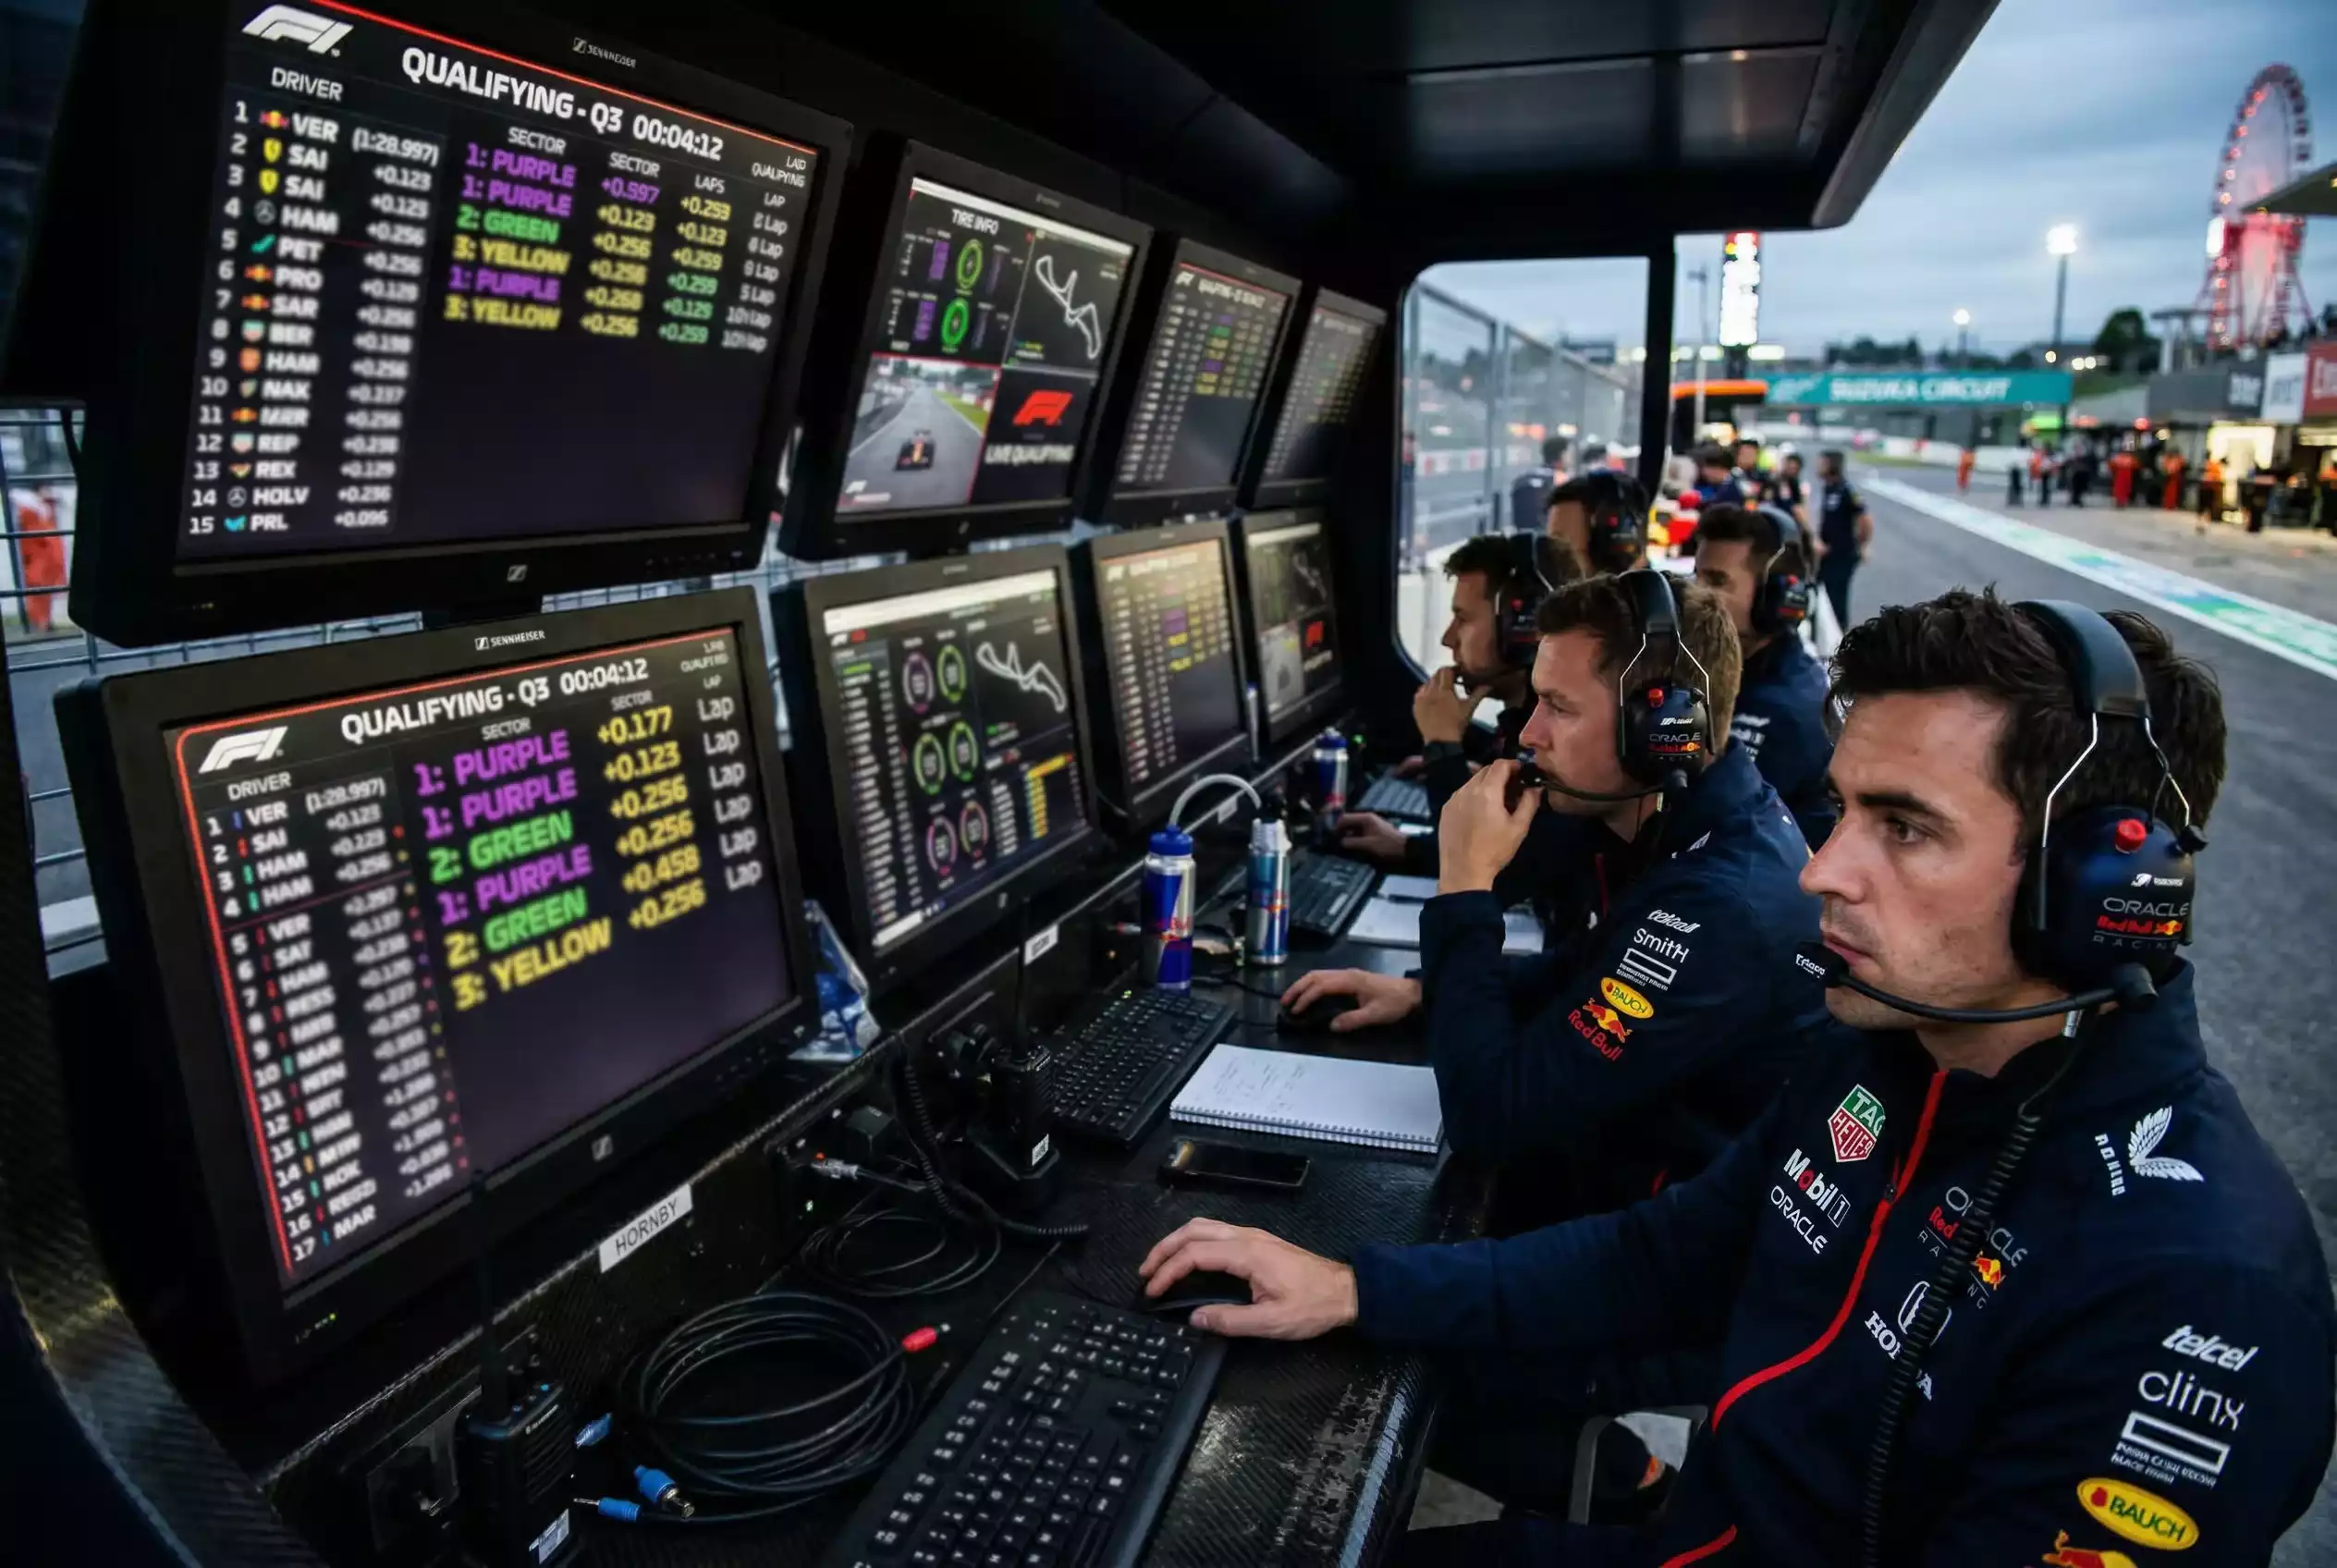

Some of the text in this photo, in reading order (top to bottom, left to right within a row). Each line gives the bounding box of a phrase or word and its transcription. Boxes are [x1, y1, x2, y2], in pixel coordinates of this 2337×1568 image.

[271, 67, 343, 101] DRIVER
[402, 47, 574, 119] QUALIFYING
[591, 103, 623, 134] Q3
[633, 115, 724, 161] 00:04:12
[235, 101, 248, 123] 1
[292, 113, 338, 142] VER
[231, 133, 247, 154] 2
[288, 144, 327, 170] SAI
[508, 127, 567, 155] SECTOR
[465, 142, 577, 188] 1: PURPLE
[609, 152, 660, 178] SECTOR
[228, 165, 324, 200] 3 SAI
[462, 174, 572, 217] 1: PURPLE
[695, 174, 725, 194] LAPS
[224, 197, 241, 218] 4
[281, 205, 338, 234] HAM
[457, 204, 559, 244] 2: GREEN
[222, 228, 238, 251] 5
[481, 239, 570, 274] YELLOW
[219, 260, 234, 280] 6
[216, 289, 232, 310] 7
[472, 299, 562, 330] YELLOW
[209, 348, 226, 368] 9
[202, 376, 227, 397] 10
[200, 405, 223, 424] 11
[197, 434, 222, 451] 12
[194, 462, 220, 479] 13
[192, 489, 217, 507] 14
[190, 515, 288, 534] 15 PRL
[490, 630, 545, 646] SENNHEISER
[341, 686, 503, 744] QUALIFYING
[518, 677, 550, 707] Q3
[559, 658, 649, 695] 00:04:12
[610, 690, 653, 712] SECTOR
[697, 696, 735, 721] Lap
[482, 717, 532, 741] SECTOR
[597, 705, 673, 745] +0.177
[703, 729, 740, 755] Lap
[414, 729, 571, 796] 1: PURPLE
[604, 741, 682, 781] +0.123
[708, 763, 746, 790] Lap
[227, 771, 291, 801] DRIVER
[422, 767, 579, 839] 1: PURPLE
[610, 774, 690, 819] +0.256
[207, 816, 223, 837] 1
[245, 801, 288, 827] VER
[714, 795, 752, 824] Lap
[213, 828, 288, 864] 2 SAI
[428, 809, 573, 884] 2: GREEN
[719, 827, 758, 858] Lap
[217, 851, 308, 891] 3 HAM
[437, 843, 593, 925] 1: PURPLE
[725, 860, 763, 890] Lap
[224, 876, 313, 916] 4 HAM
[2102, 898, 2189, 916] ORACLE
[231, 913, 310, 955] 5 VER
[444, 886, 589, 969] 2: GREEN
[490, 917, 612, 992] YELLOW
[241, 986, 258, 1008] 7
[1568, 1009, 1623, 1061] Red Bull
[259, 1088, 286, 1113] 11
[275, 1162, 301, 1189] 14
[1783, 1148, 1839, 1211] Mobil
[281, 1188, 306, 1213] 15
[288, 1213, 312, 1238] 16
[293, 1204, 376, 1262] 17 MAR
[614, 1197, 678, 1256] HORNBY
[1770, 1185, 1829, 1255] ORACLE
[2161, 1325, 2259, 1372] telcel
[2110, 1495, 2187, 1542] BAUCH
